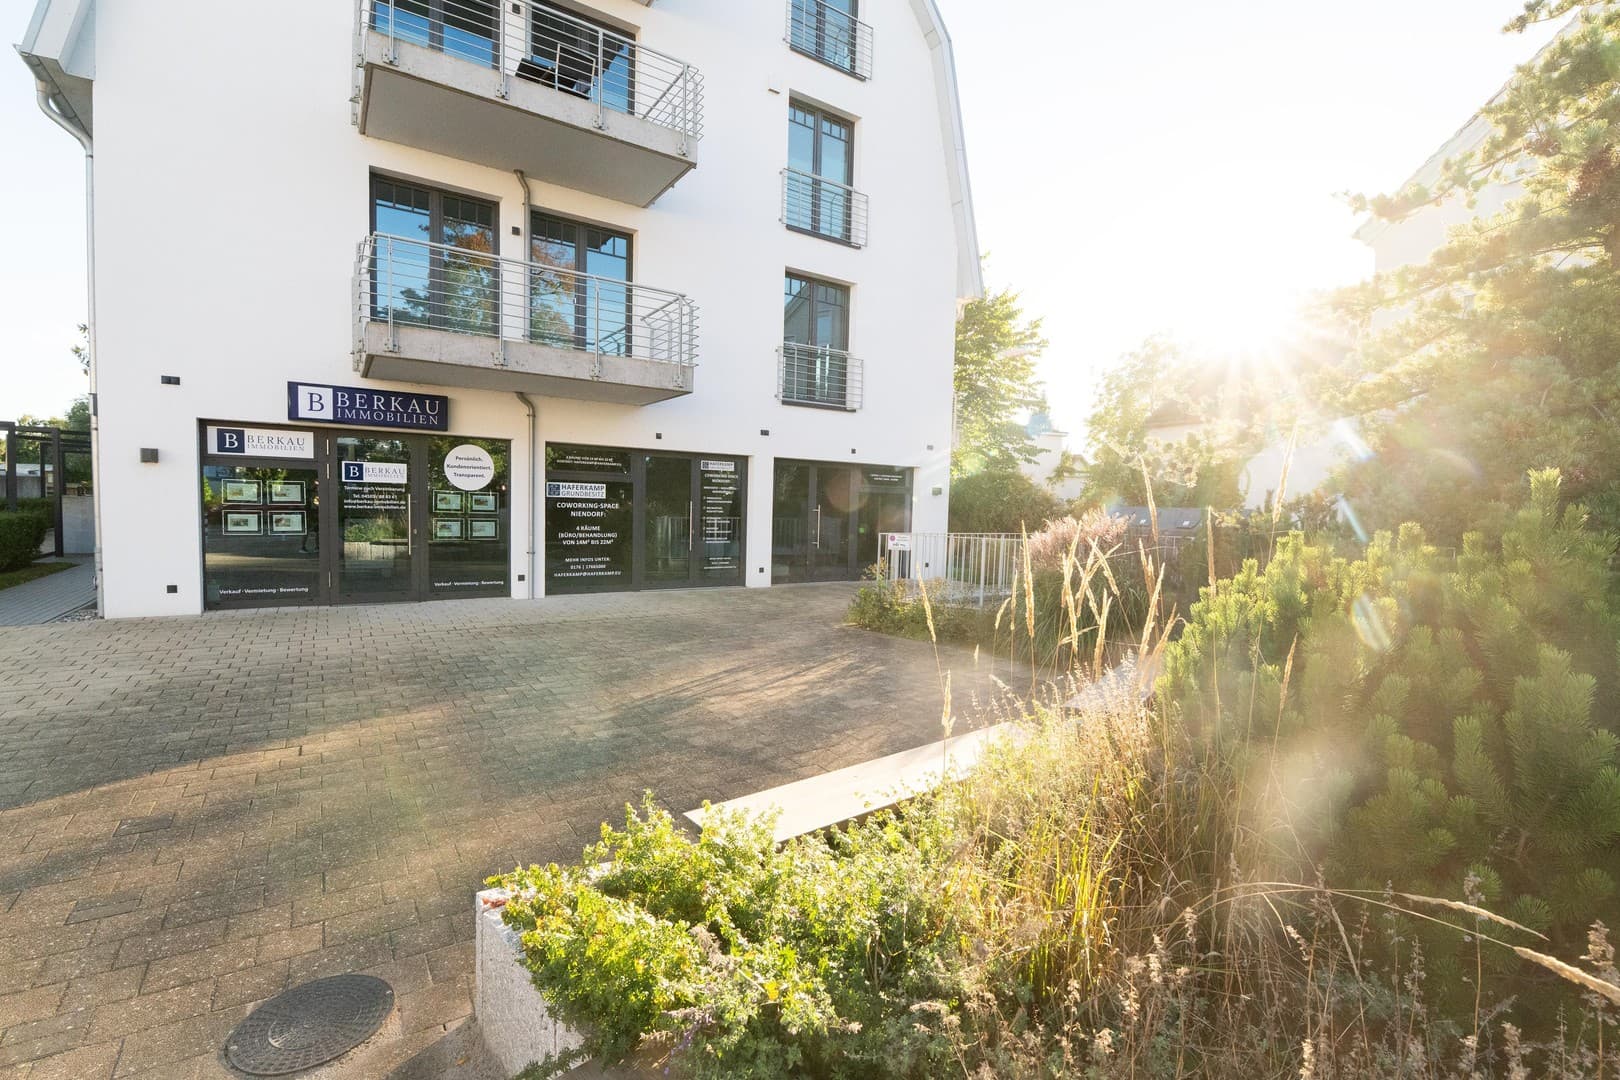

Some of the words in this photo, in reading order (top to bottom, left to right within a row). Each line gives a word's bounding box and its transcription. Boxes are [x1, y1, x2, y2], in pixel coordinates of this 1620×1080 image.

[307, 392, 325, 412] B
[336, 391, 440, 415] BERKAU
[337, 408, 439, 425] IMMOBILIEN
[224, 432, 238, 448] B
[247, 435, 305, 446] BERKAU
[247, 444, 305, 452] IMMOBILIEN
[349, 465, 360, 477] B
[365, 467, 405, 475] BERKAU
[561, 484, 605, 492] HAFERKAMP
[561, 490, 605, 498] GRUNDBESITZ
[556, 502, 620, 510] COWORKING-SPACE
[558, 531, 618, 539] (BÜRO/BEHANDLUNG)
